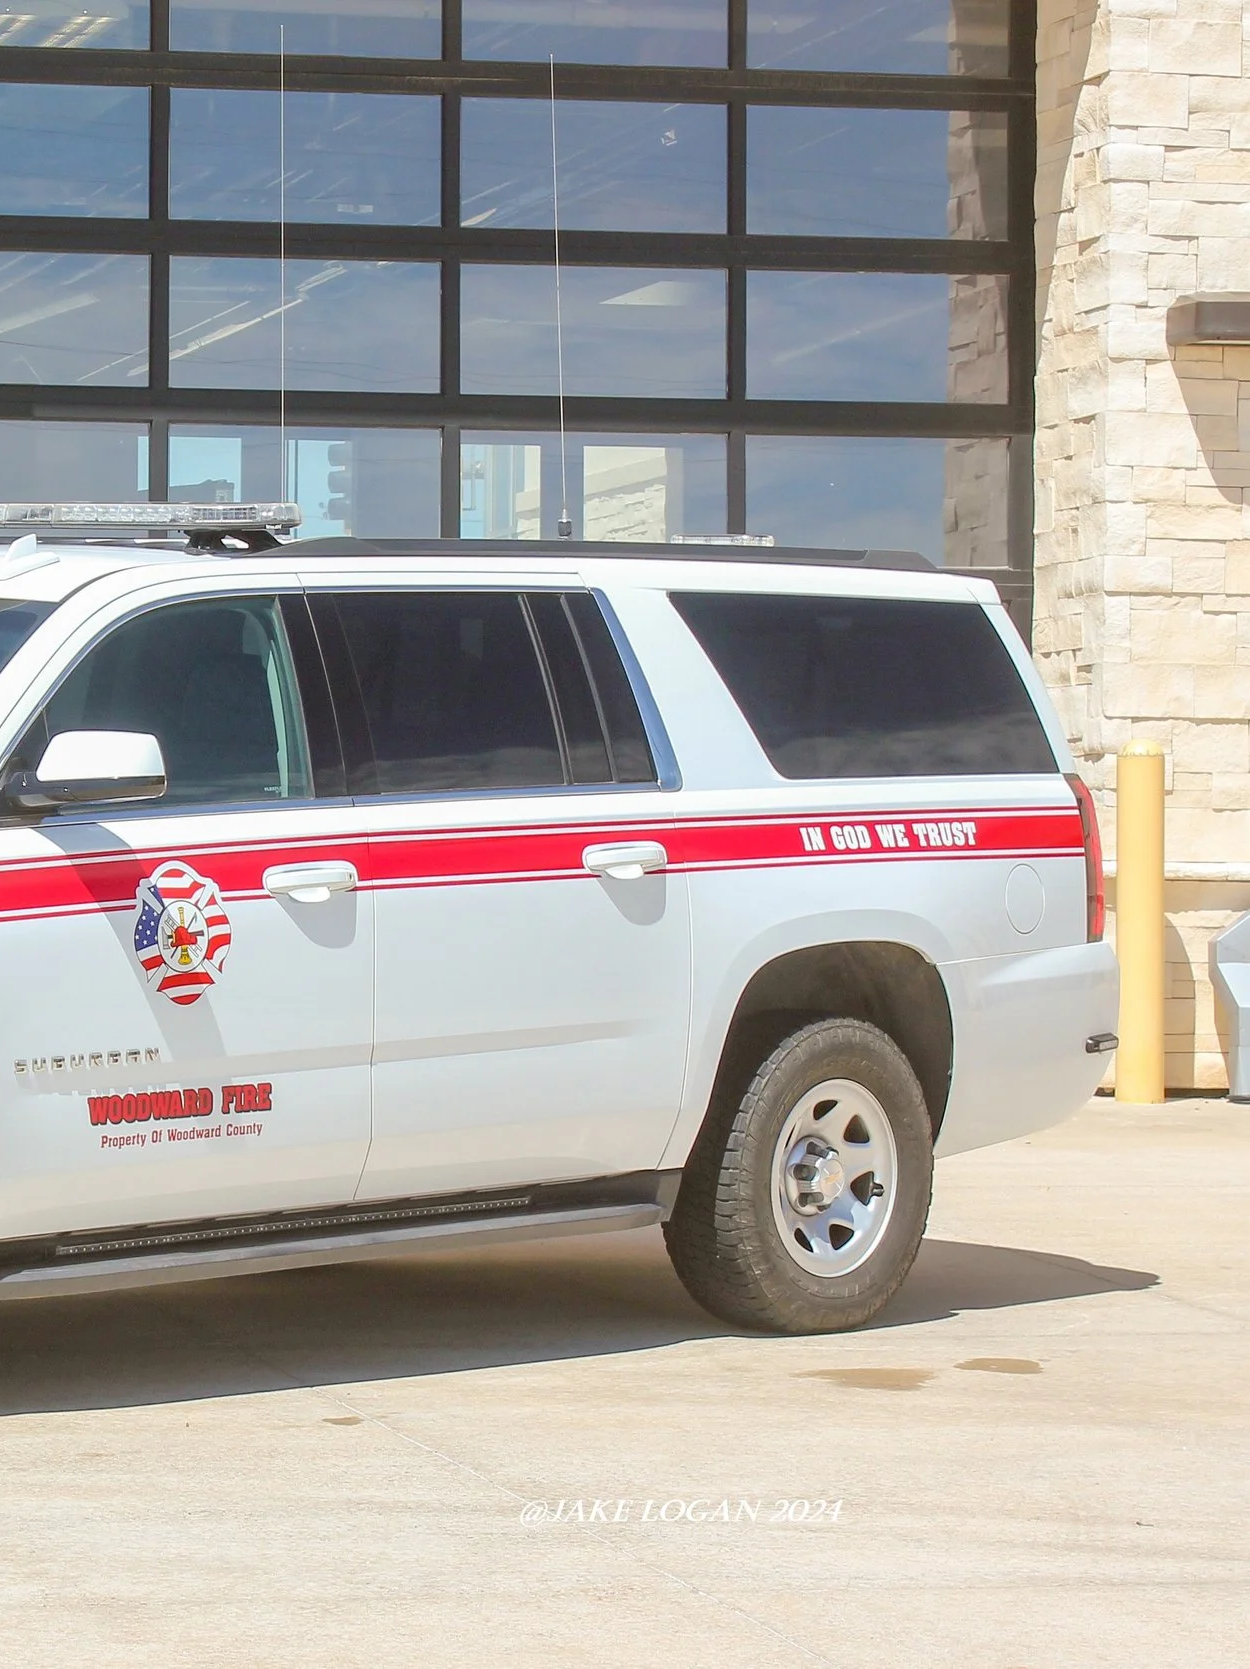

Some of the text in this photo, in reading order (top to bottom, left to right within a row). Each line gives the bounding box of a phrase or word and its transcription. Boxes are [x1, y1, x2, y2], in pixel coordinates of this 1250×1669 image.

[799, 821, 977, 851] IN GOD WE TRUST
[14, 1047, 160, 1074] SUBURBAN
[87, 1082, 273, 1126] WOODWARD FIRE
[101, 1122, 263, 1150] Property Of Woodward County
